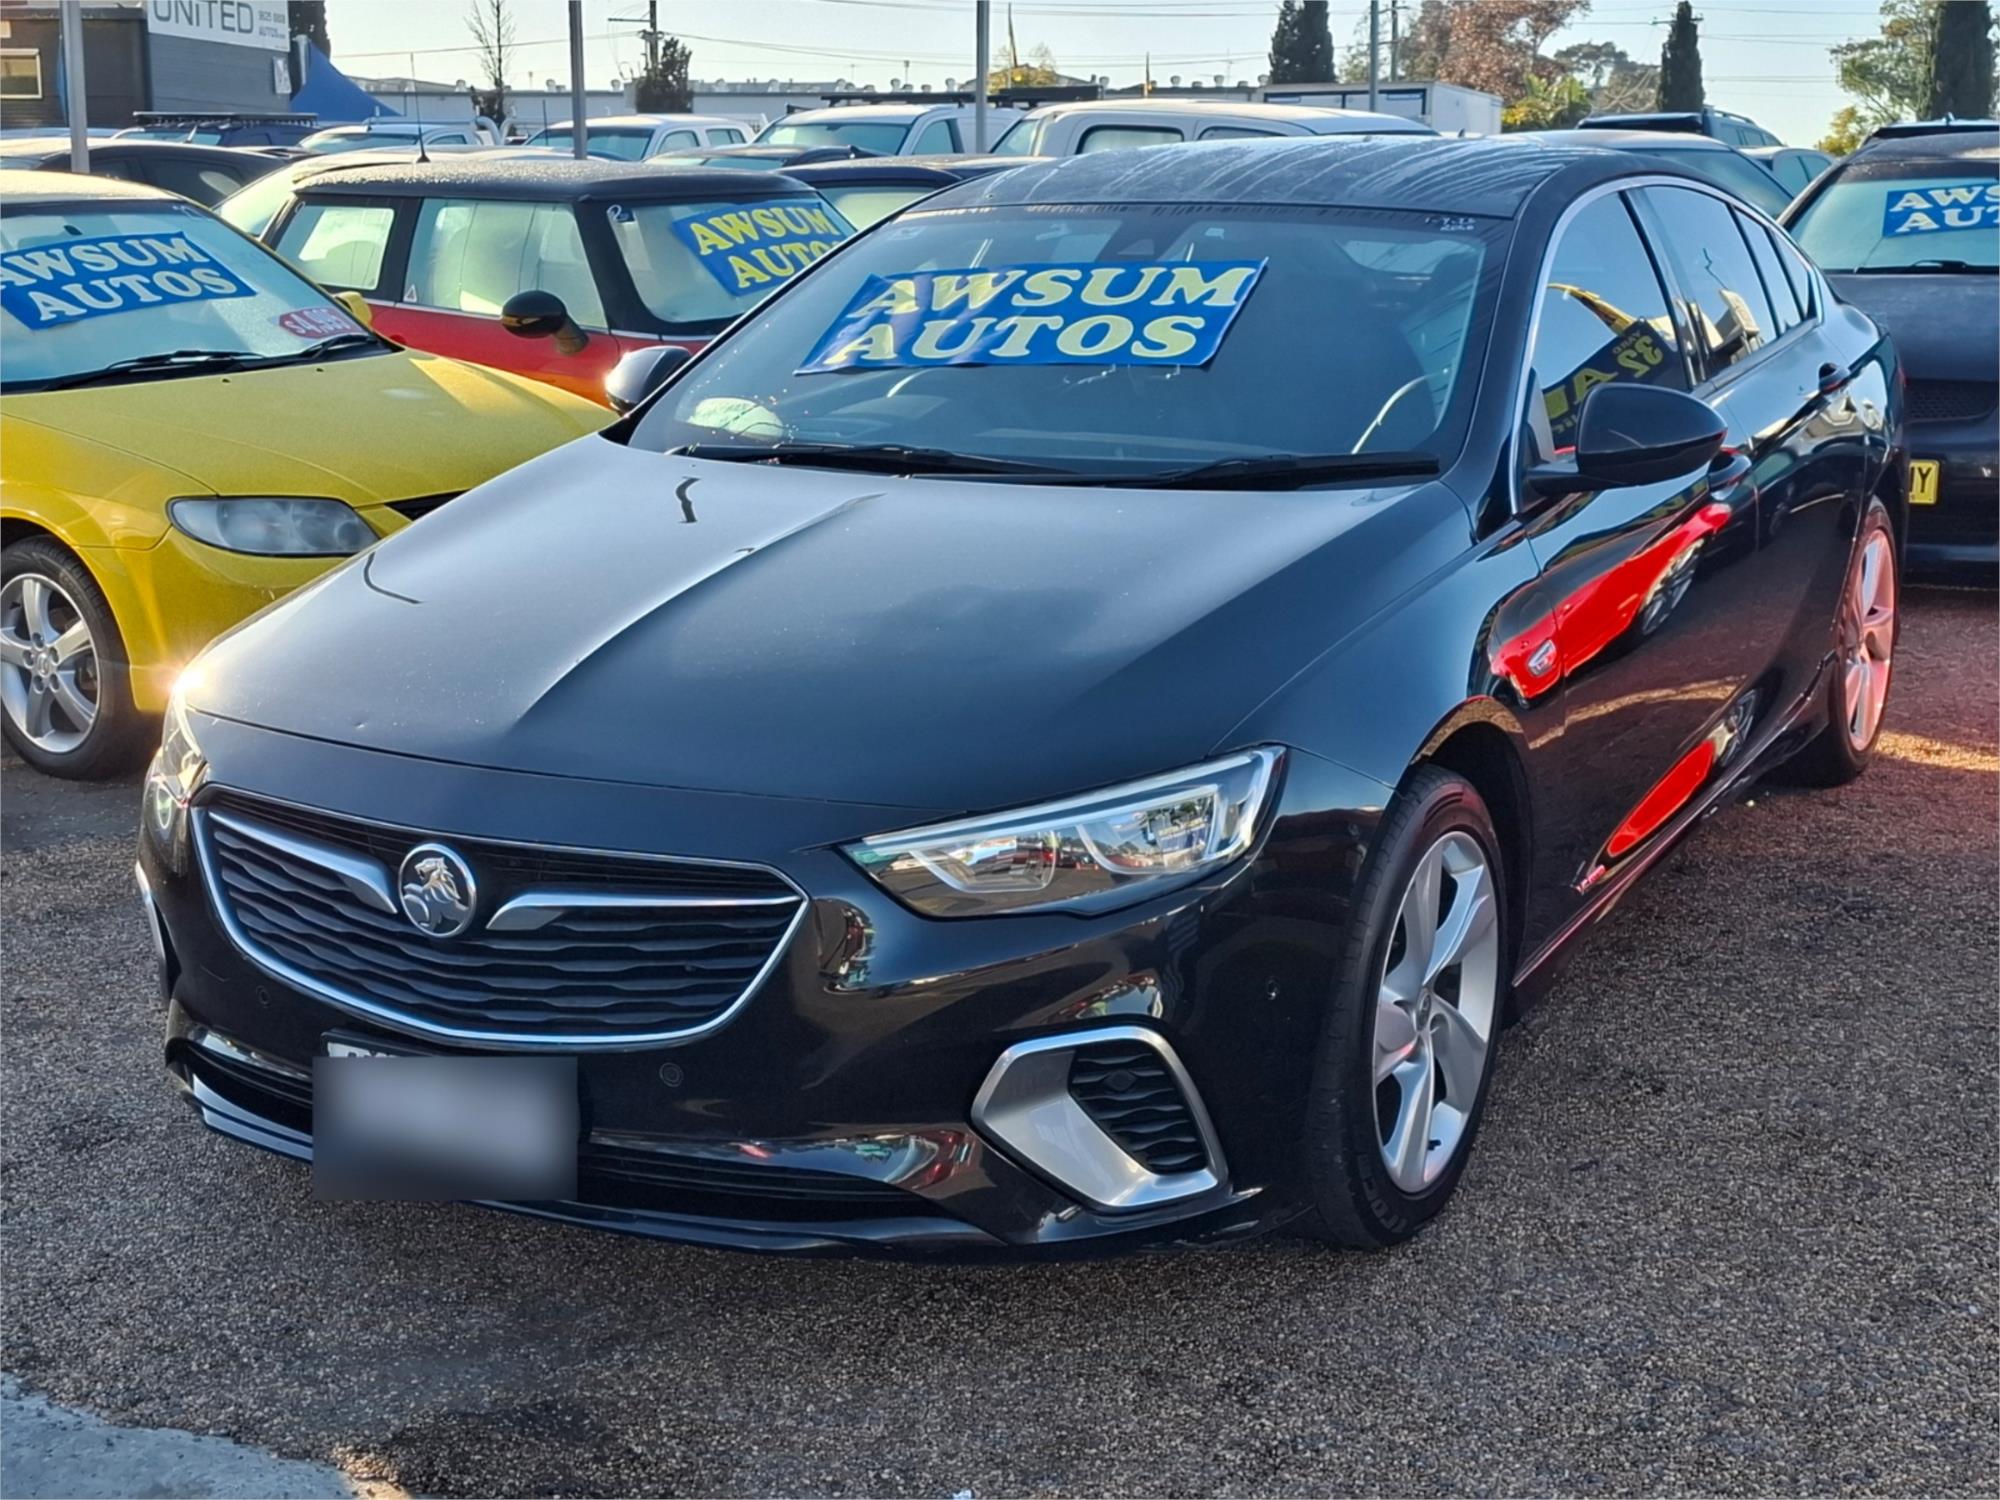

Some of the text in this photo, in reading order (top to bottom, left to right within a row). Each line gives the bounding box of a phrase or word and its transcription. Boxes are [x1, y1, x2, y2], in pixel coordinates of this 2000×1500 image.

[690, 207, 841, 255] AWSUM
[728, 241, 838, 288] AUTO
[28, 268, 238, 321] AUTOS
[847, 267, 1257, 319] AWSUM
[822, 315, 1206, 366] AUTOS
